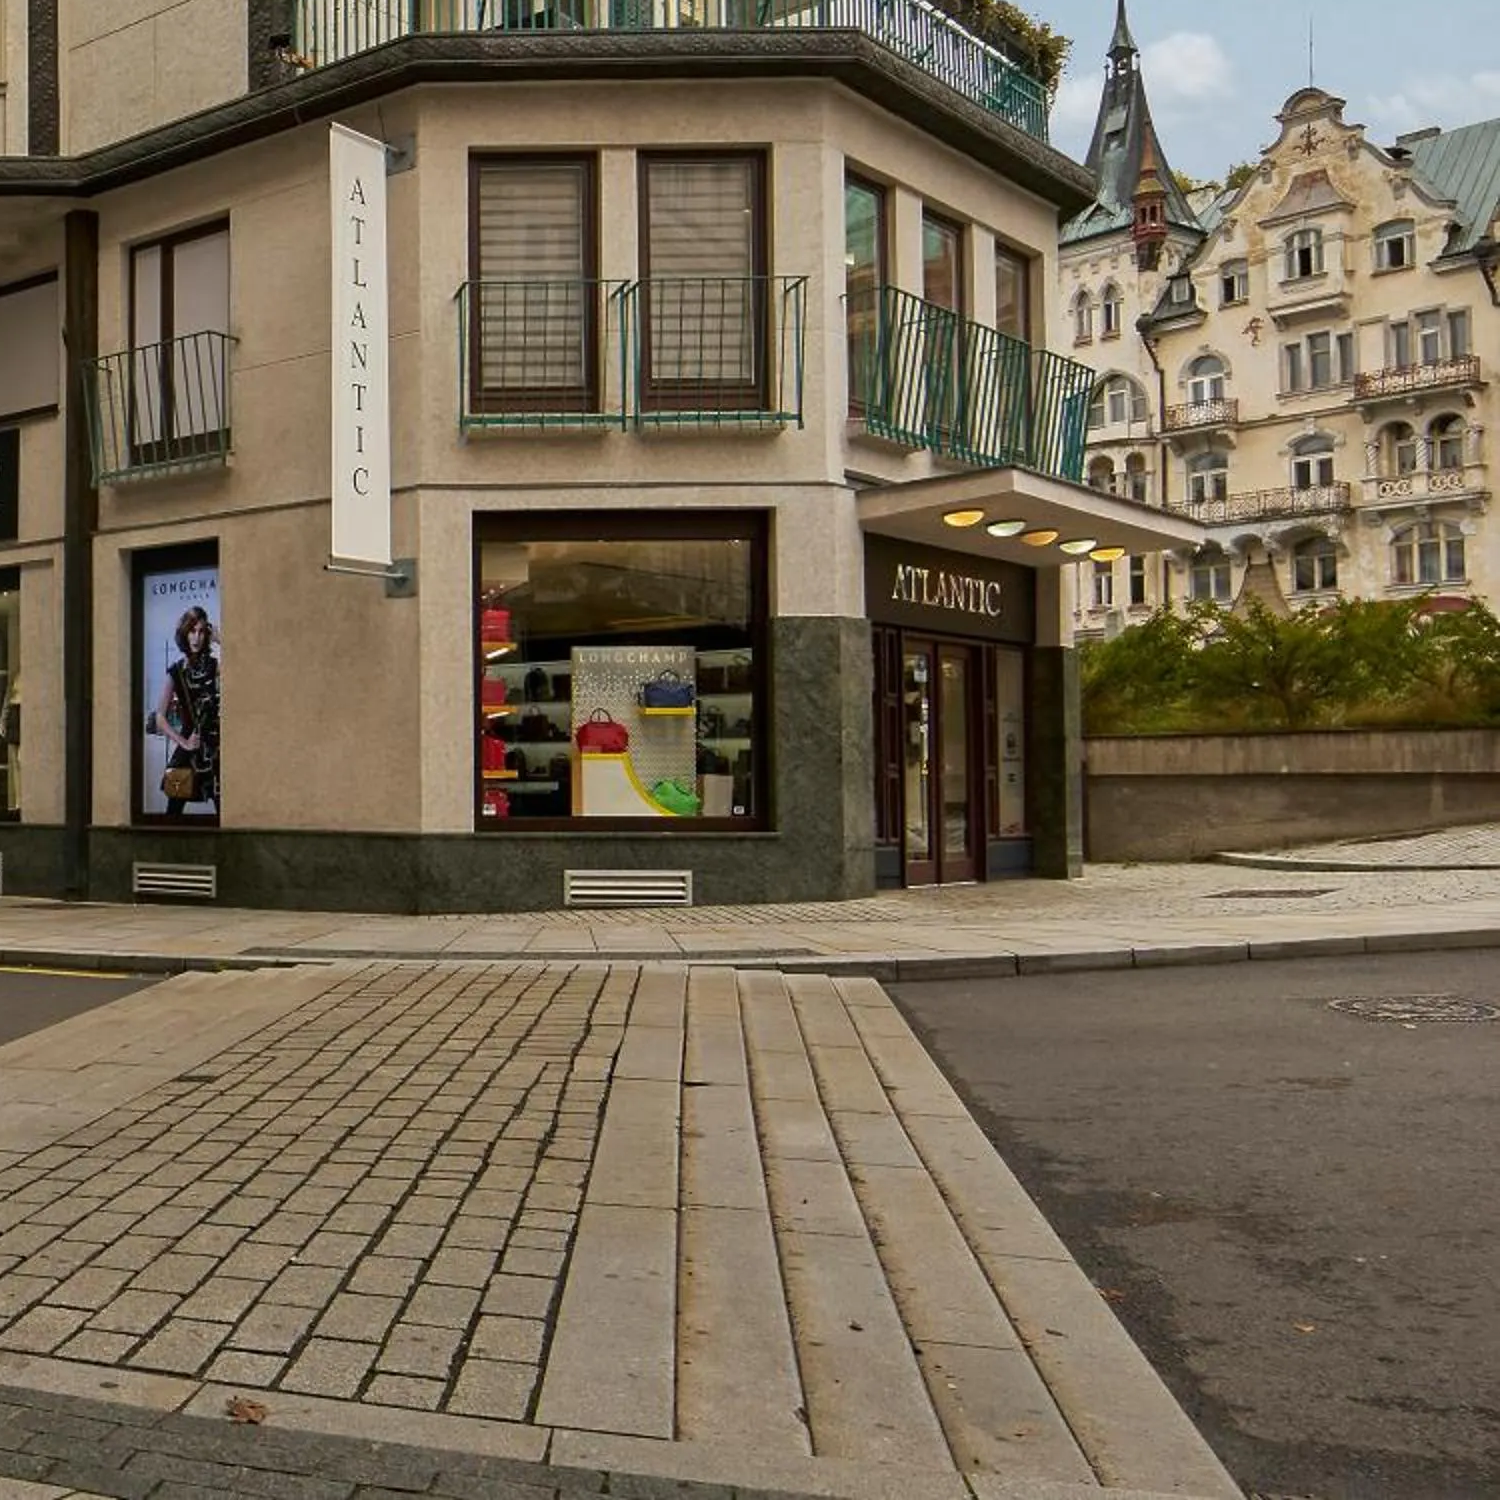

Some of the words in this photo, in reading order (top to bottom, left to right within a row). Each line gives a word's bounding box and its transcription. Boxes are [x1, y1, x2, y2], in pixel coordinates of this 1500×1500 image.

[350, 176, 370, 497] ATLANTIC
[891, 563, 1002, 617] ATLANTIC
[579, 651, 688, 664] LONGCHAMP
